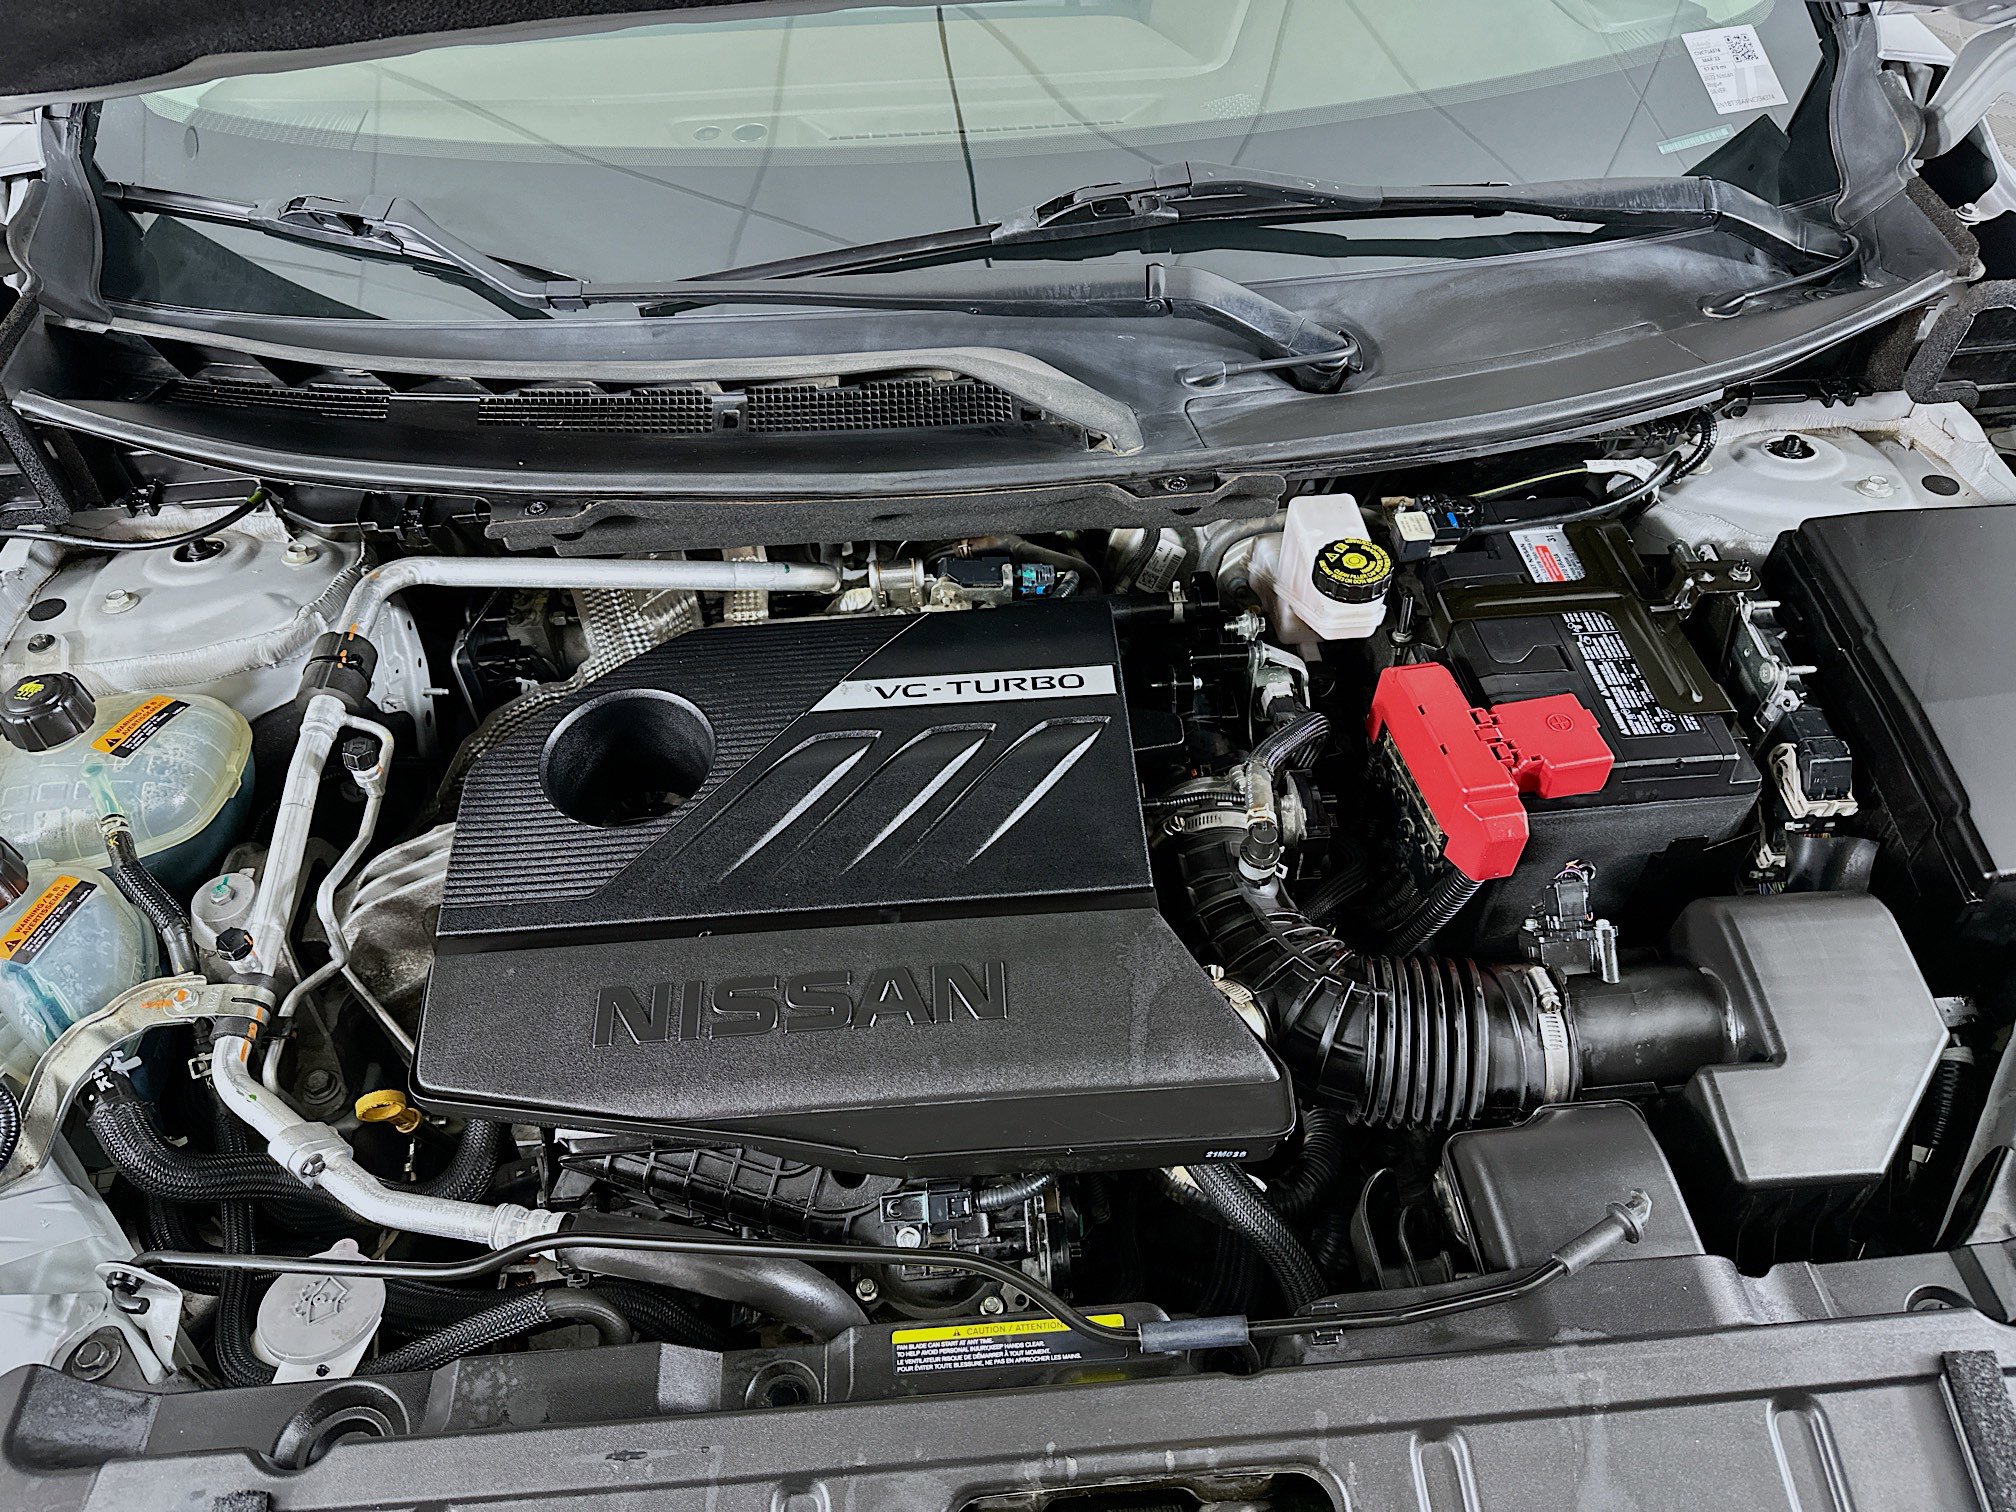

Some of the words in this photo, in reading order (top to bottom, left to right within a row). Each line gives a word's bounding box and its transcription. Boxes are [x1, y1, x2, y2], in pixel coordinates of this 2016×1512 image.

[874, 674, 1085, 699] VC-TURBO
[14, 904, 44, 933] WARNING
[22, 884, 70, 936] AVERTISSEMENT
[593, 961, 1008, 1048] NISSAN
[967, 1325, 1006, 1335] CAUTION
[1015, 1322, 1064, 1332] ATTENTION
[939, 1347, 970, 1355] PERSONAL
[1015, 1354, 1050, 1363] APPROCHER
